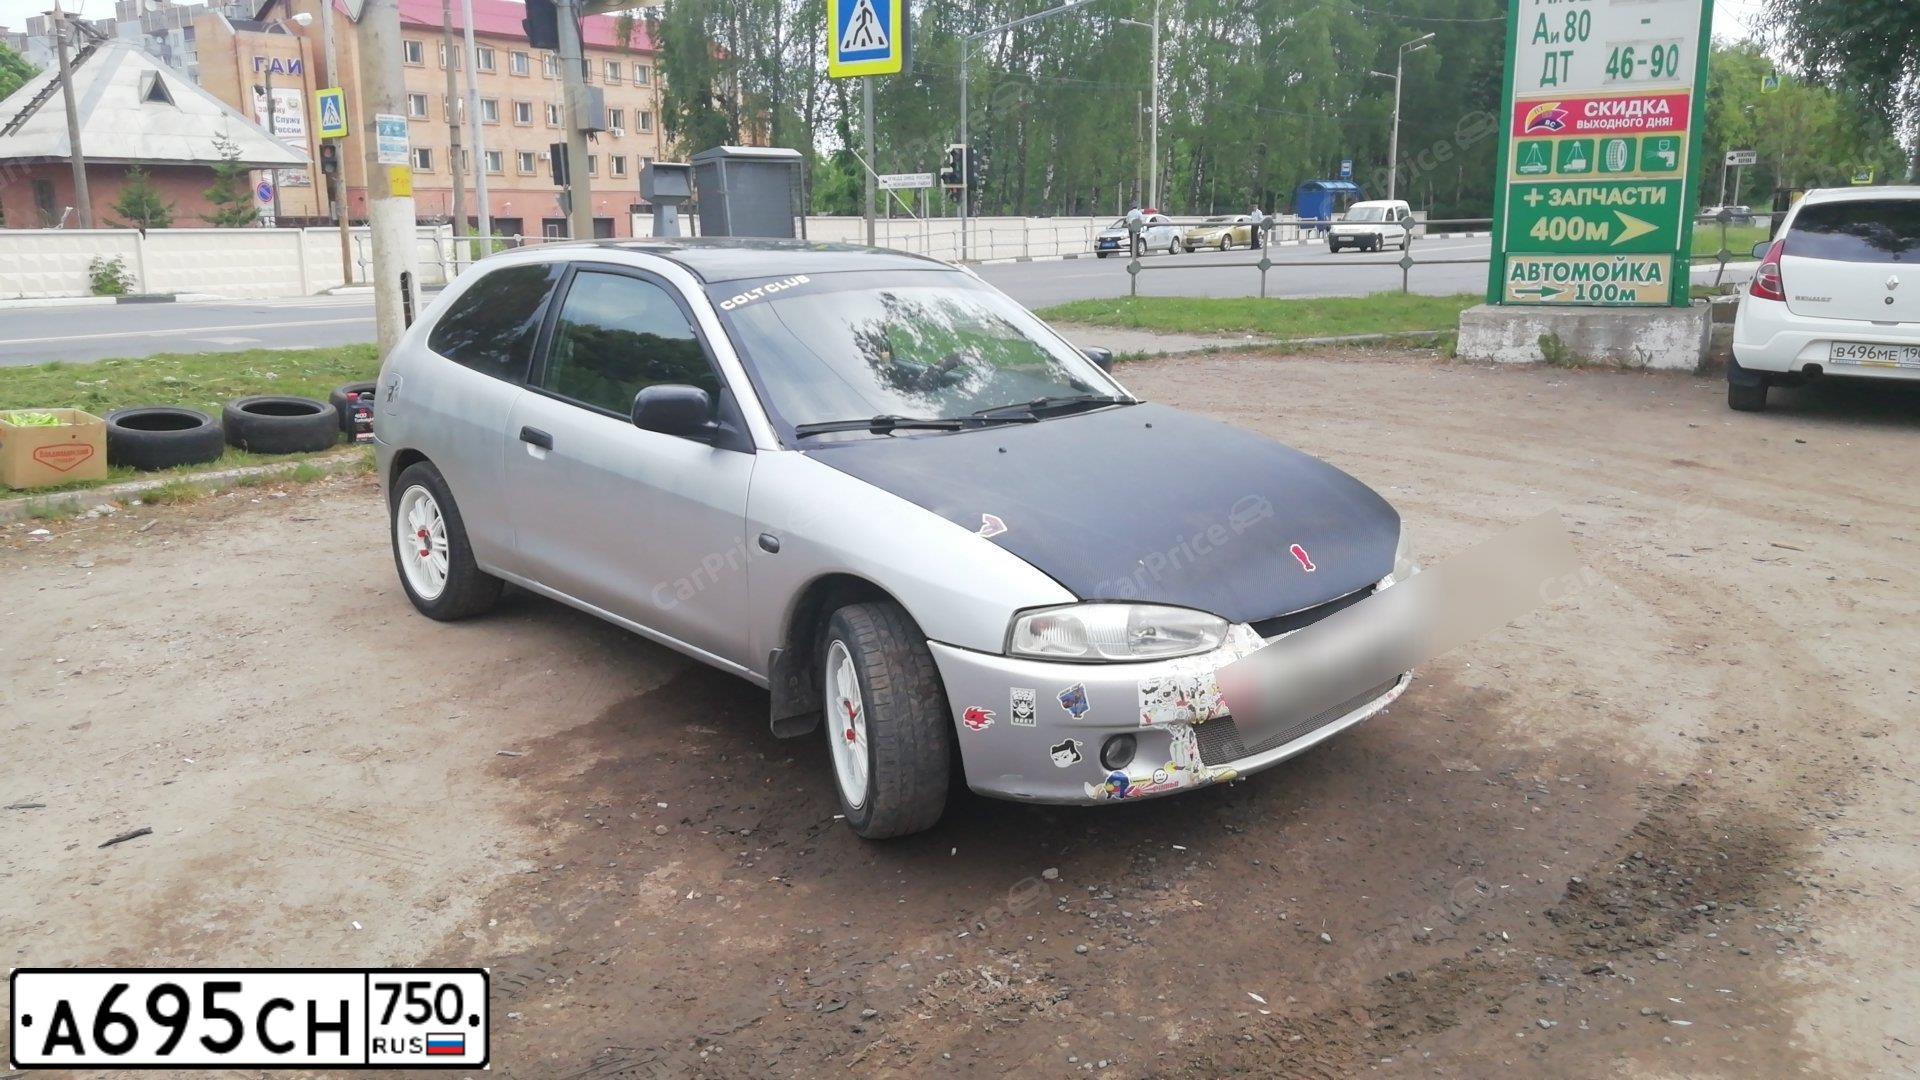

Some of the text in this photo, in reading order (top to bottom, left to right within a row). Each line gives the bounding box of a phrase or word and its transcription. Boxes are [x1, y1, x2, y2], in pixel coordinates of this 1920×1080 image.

[1564, 9, 1591, 42] 80
[253, 56, 303, 76] ГАИ
[1539, 44, 1679, 87] ДТ 46-90
[1584, 99, 1670, 118] СКИДКА
[1577, 117, 1673, 129] ВЫХОДНОГО ДНЯ!
[1549, 186, 1666, 207] ЗАПЧАСТИ
[1510, 257, 1662, 283] АВТОМОЙКА
[720, 274, 811, 311] COLT CLUB
[1903, 347, 1920, 359] 19
